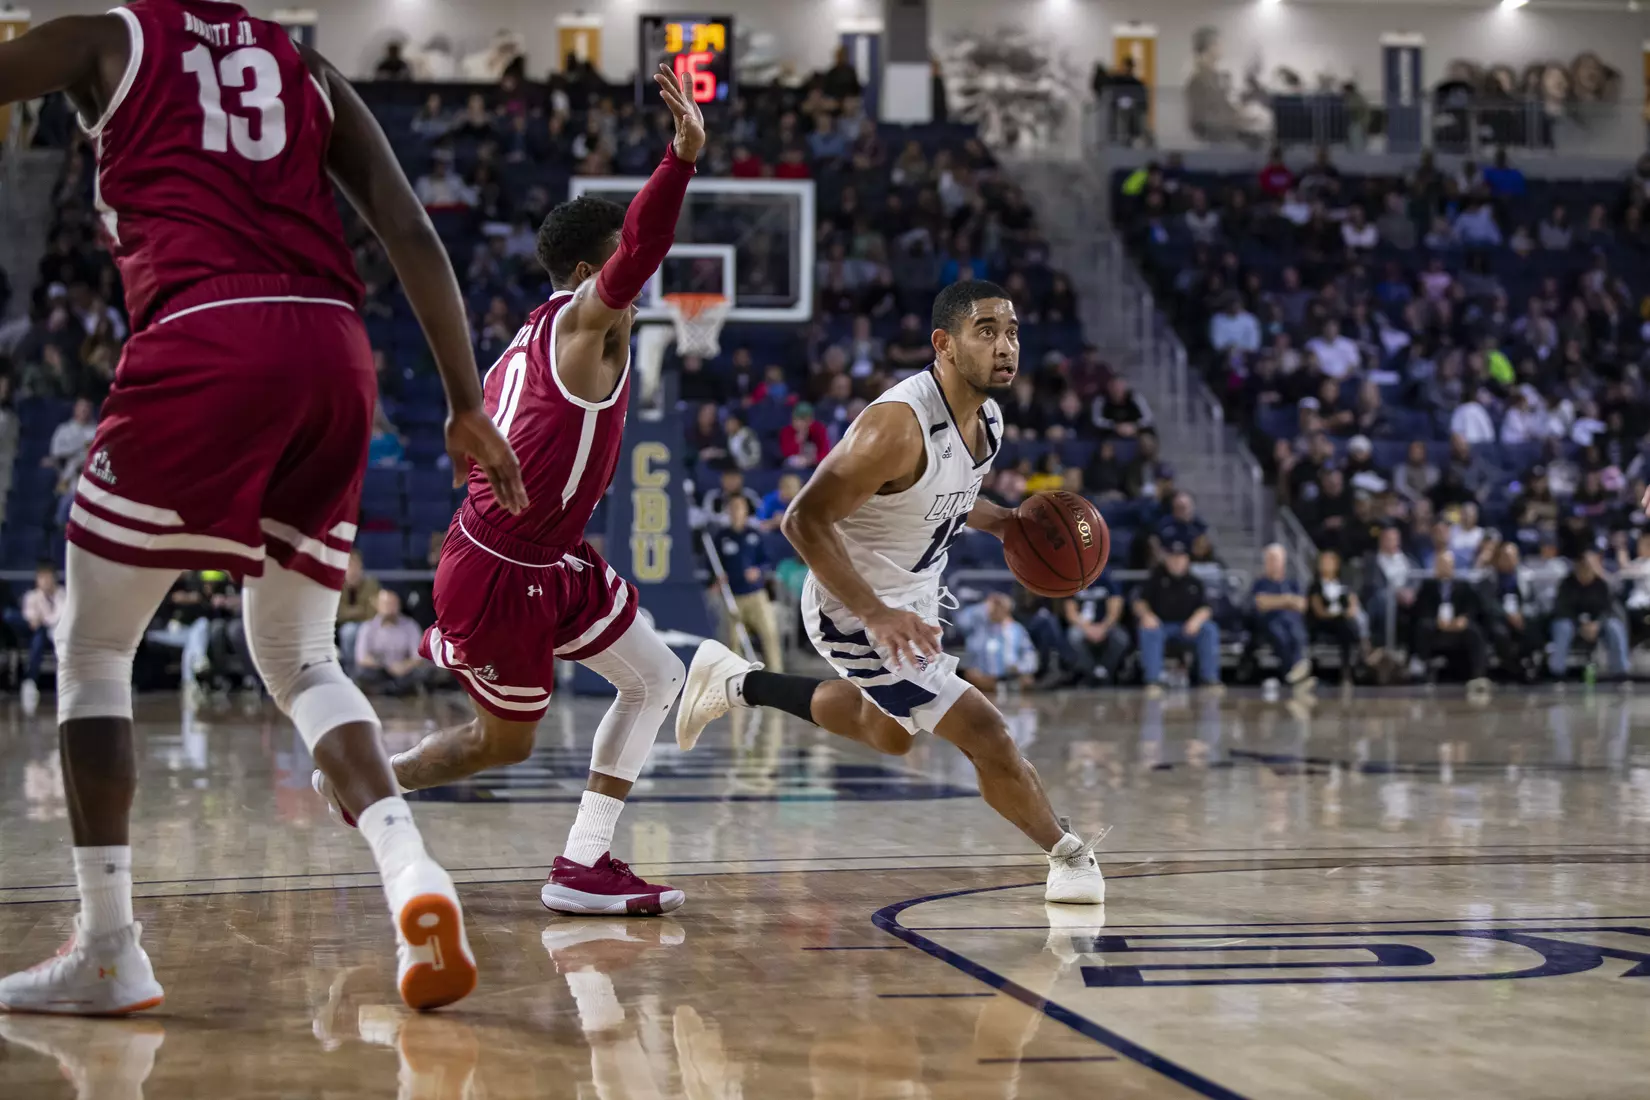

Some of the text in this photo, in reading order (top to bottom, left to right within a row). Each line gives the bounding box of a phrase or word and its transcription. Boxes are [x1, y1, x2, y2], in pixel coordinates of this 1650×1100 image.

[182, 43, 287, 161] 13
[491, 351, 527, 438] 0
[629, 441, 673, 583] CBU
